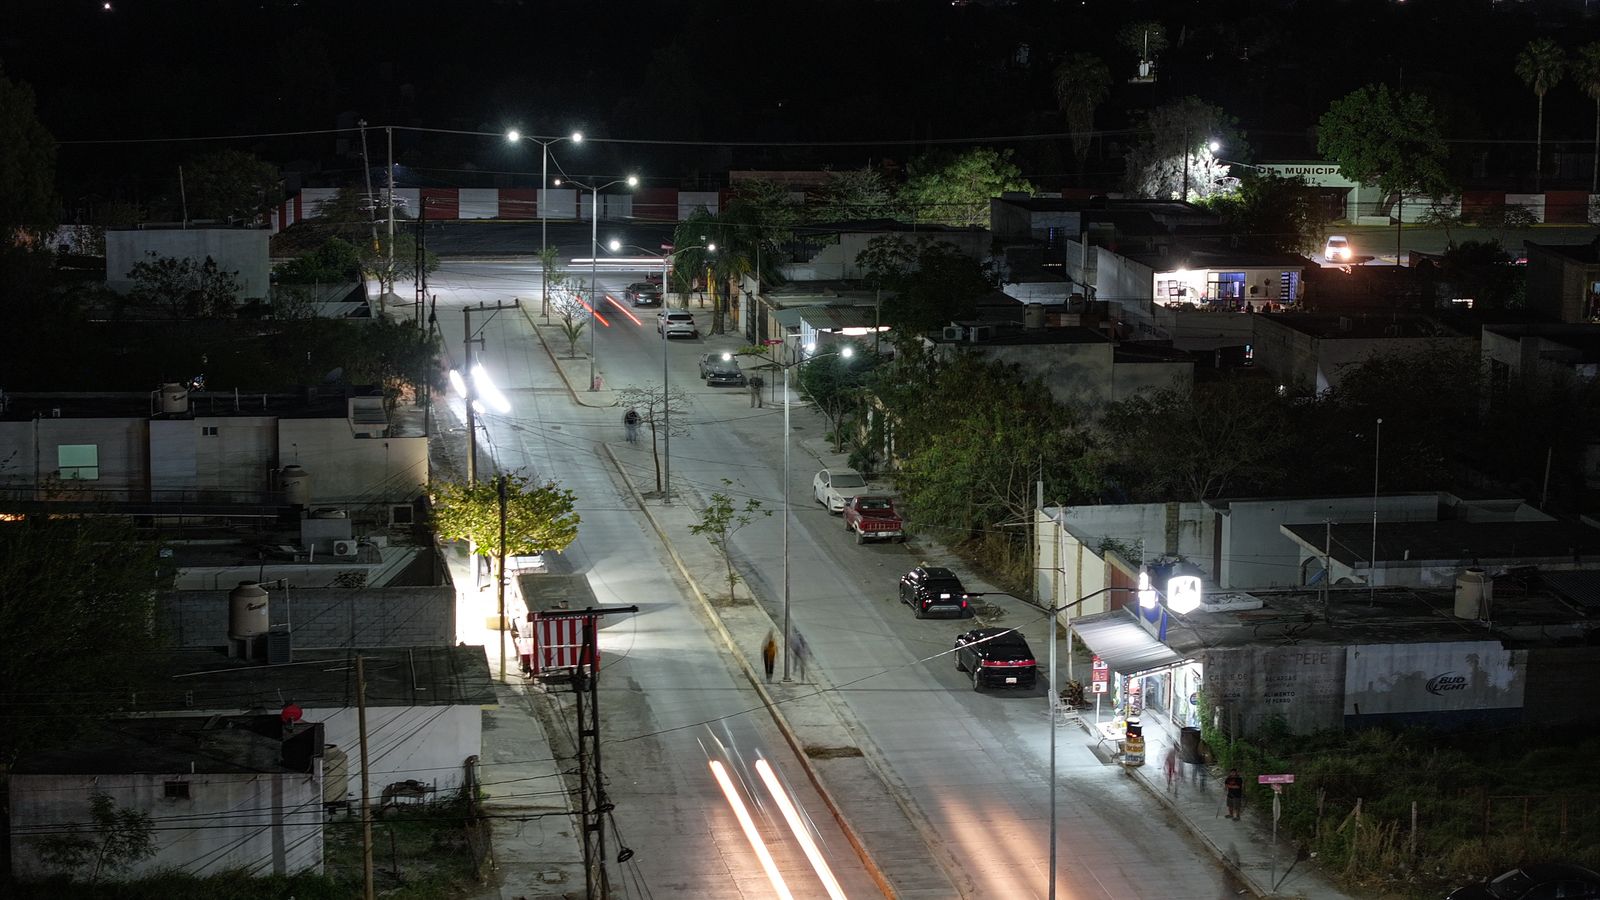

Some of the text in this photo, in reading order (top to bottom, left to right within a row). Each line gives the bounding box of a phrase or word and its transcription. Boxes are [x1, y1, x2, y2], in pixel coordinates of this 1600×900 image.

[1285, 167, 1343, 175] MUNICIPA
[1296, 653, 1329, 665] PEPE
[1439, 676, 1465, 684] BUD
[1433, 683, 1469, 691] LIGHT
